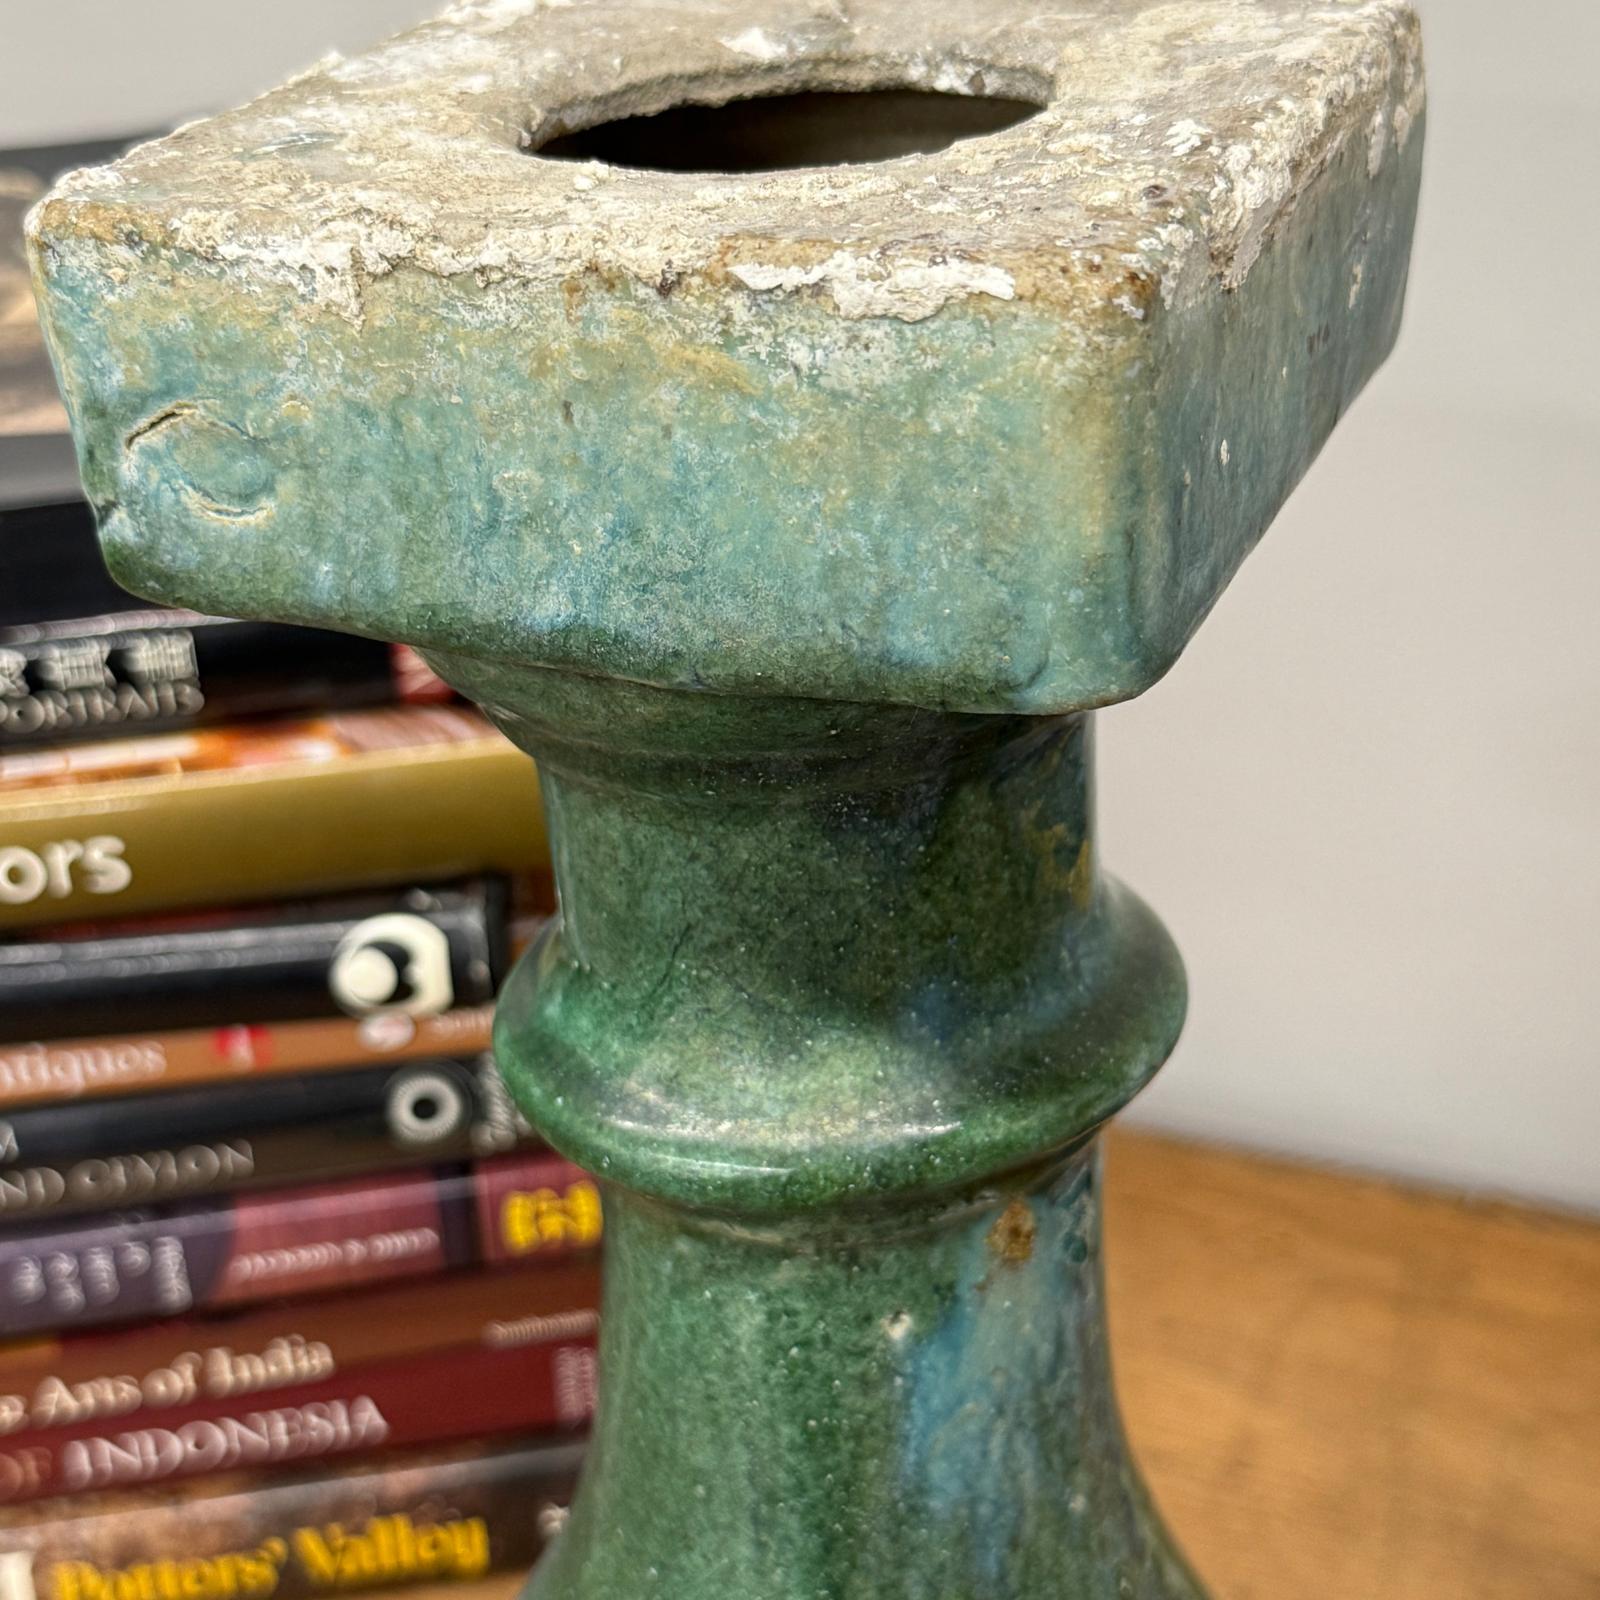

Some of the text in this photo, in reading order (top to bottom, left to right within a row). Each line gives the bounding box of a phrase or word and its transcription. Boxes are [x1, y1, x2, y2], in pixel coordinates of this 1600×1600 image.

[0, 682, 204, 733] ORTRAITS
[0, 835, 132, 904] ors
[31, 1376, 142, 1429] Arts
[141, 1352, 202, 1409] of
[203, 1334, 335, 1398] India
[62, 1395, 389, 1492] INDONESIA
[296, 1513, 490, 1586] Valley
